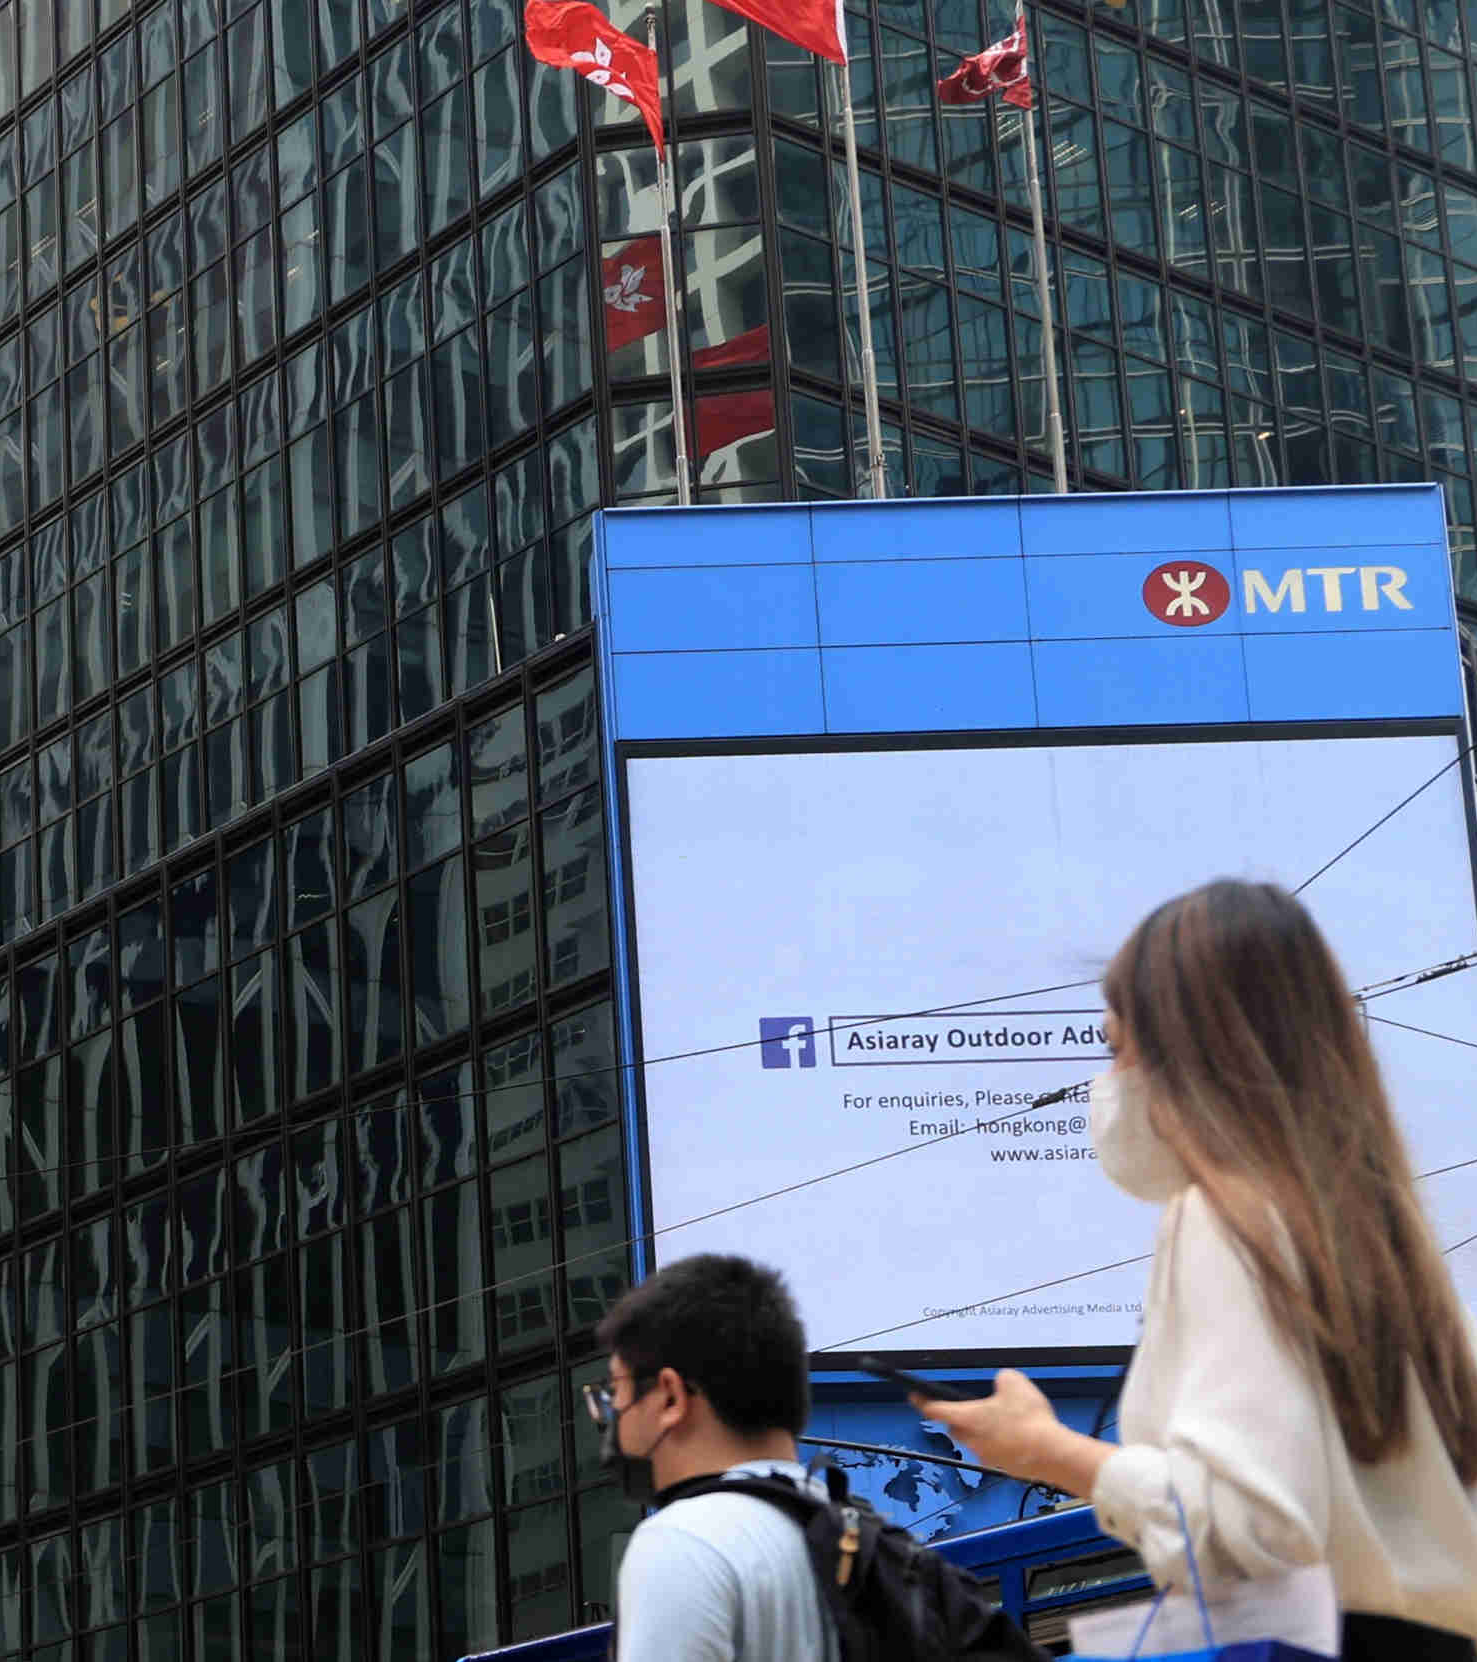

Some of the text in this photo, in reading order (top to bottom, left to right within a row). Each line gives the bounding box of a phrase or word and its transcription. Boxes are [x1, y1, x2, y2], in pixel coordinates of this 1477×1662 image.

[1243, 565, 1415, 614] MTR
[847, 1031, 938, 1052] Asiaray
[947, 1028, 1053, 1048] Outdoor
[843, 1093, 876, 1109] For
[879, 1090, 969, 1111] enquiries,
[975, 1089, 1033, 1106] Please
[909, 1115, 1088, 1137] Email: hongkong@
[1022, 1302, 1086, 1316] Advertising
[1087, 1302, 1123, 1314] Media
